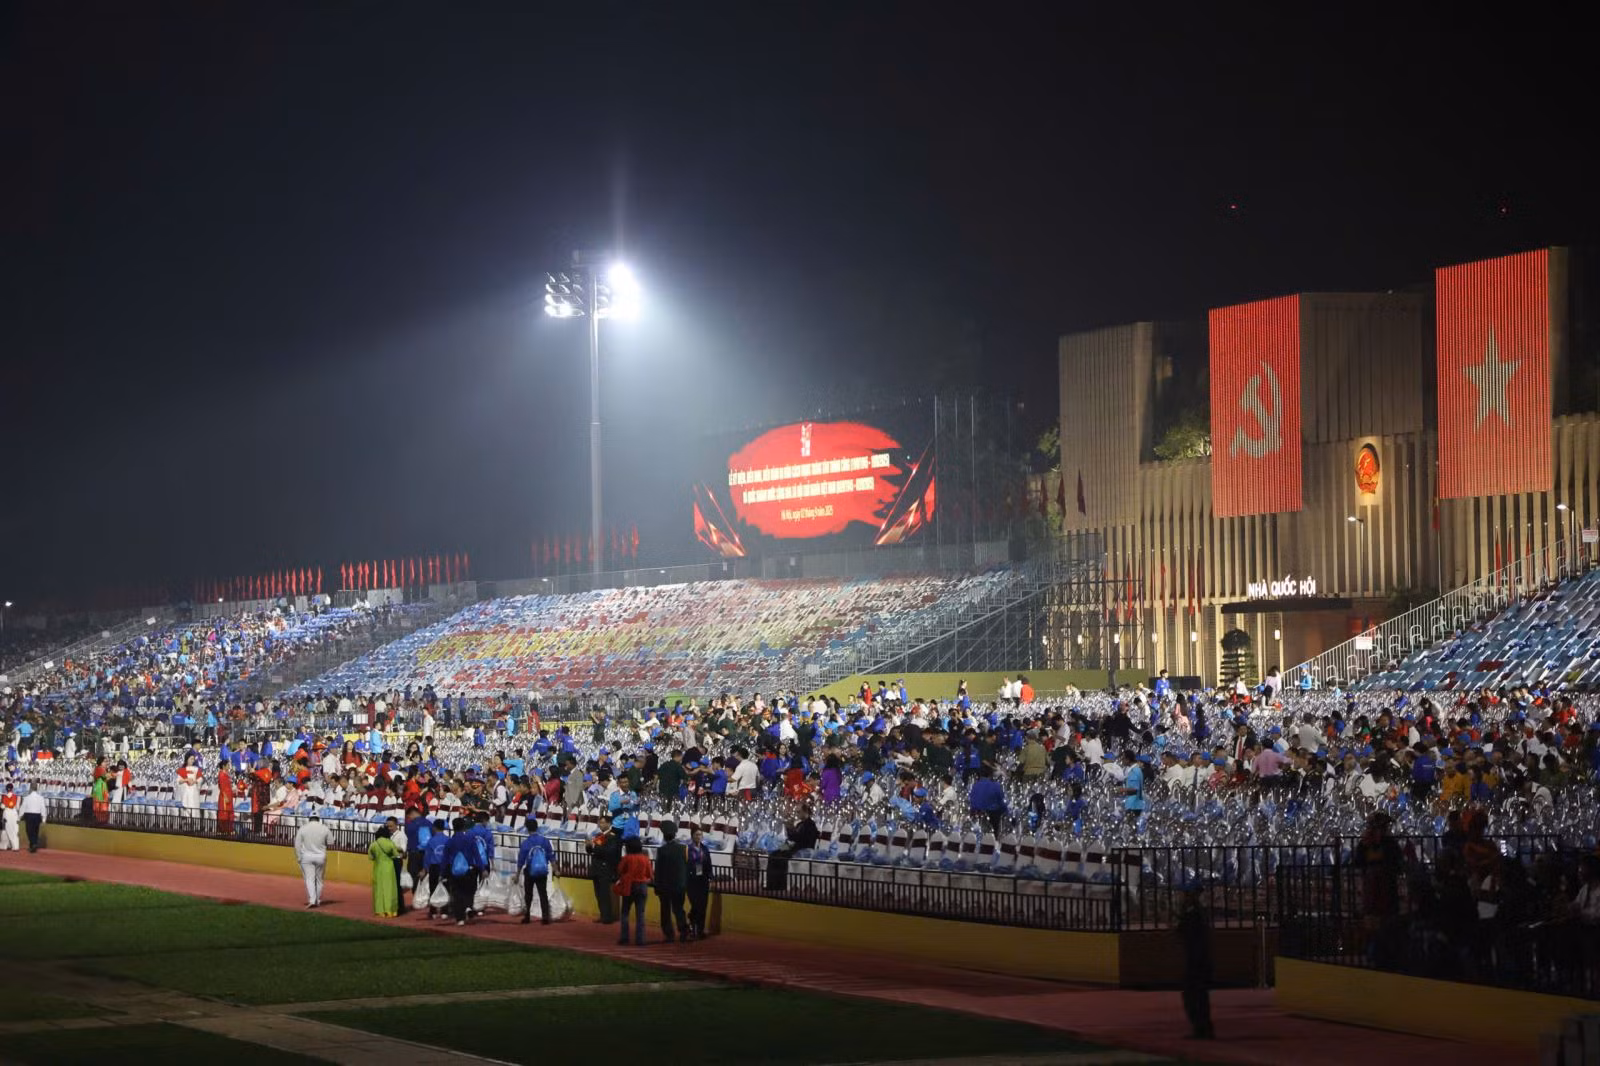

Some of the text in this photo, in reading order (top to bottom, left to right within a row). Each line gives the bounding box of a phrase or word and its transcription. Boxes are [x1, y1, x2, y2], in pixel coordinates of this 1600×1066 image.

[1248, 574, 1316, 598] NHÀ QUỐC HỘI
